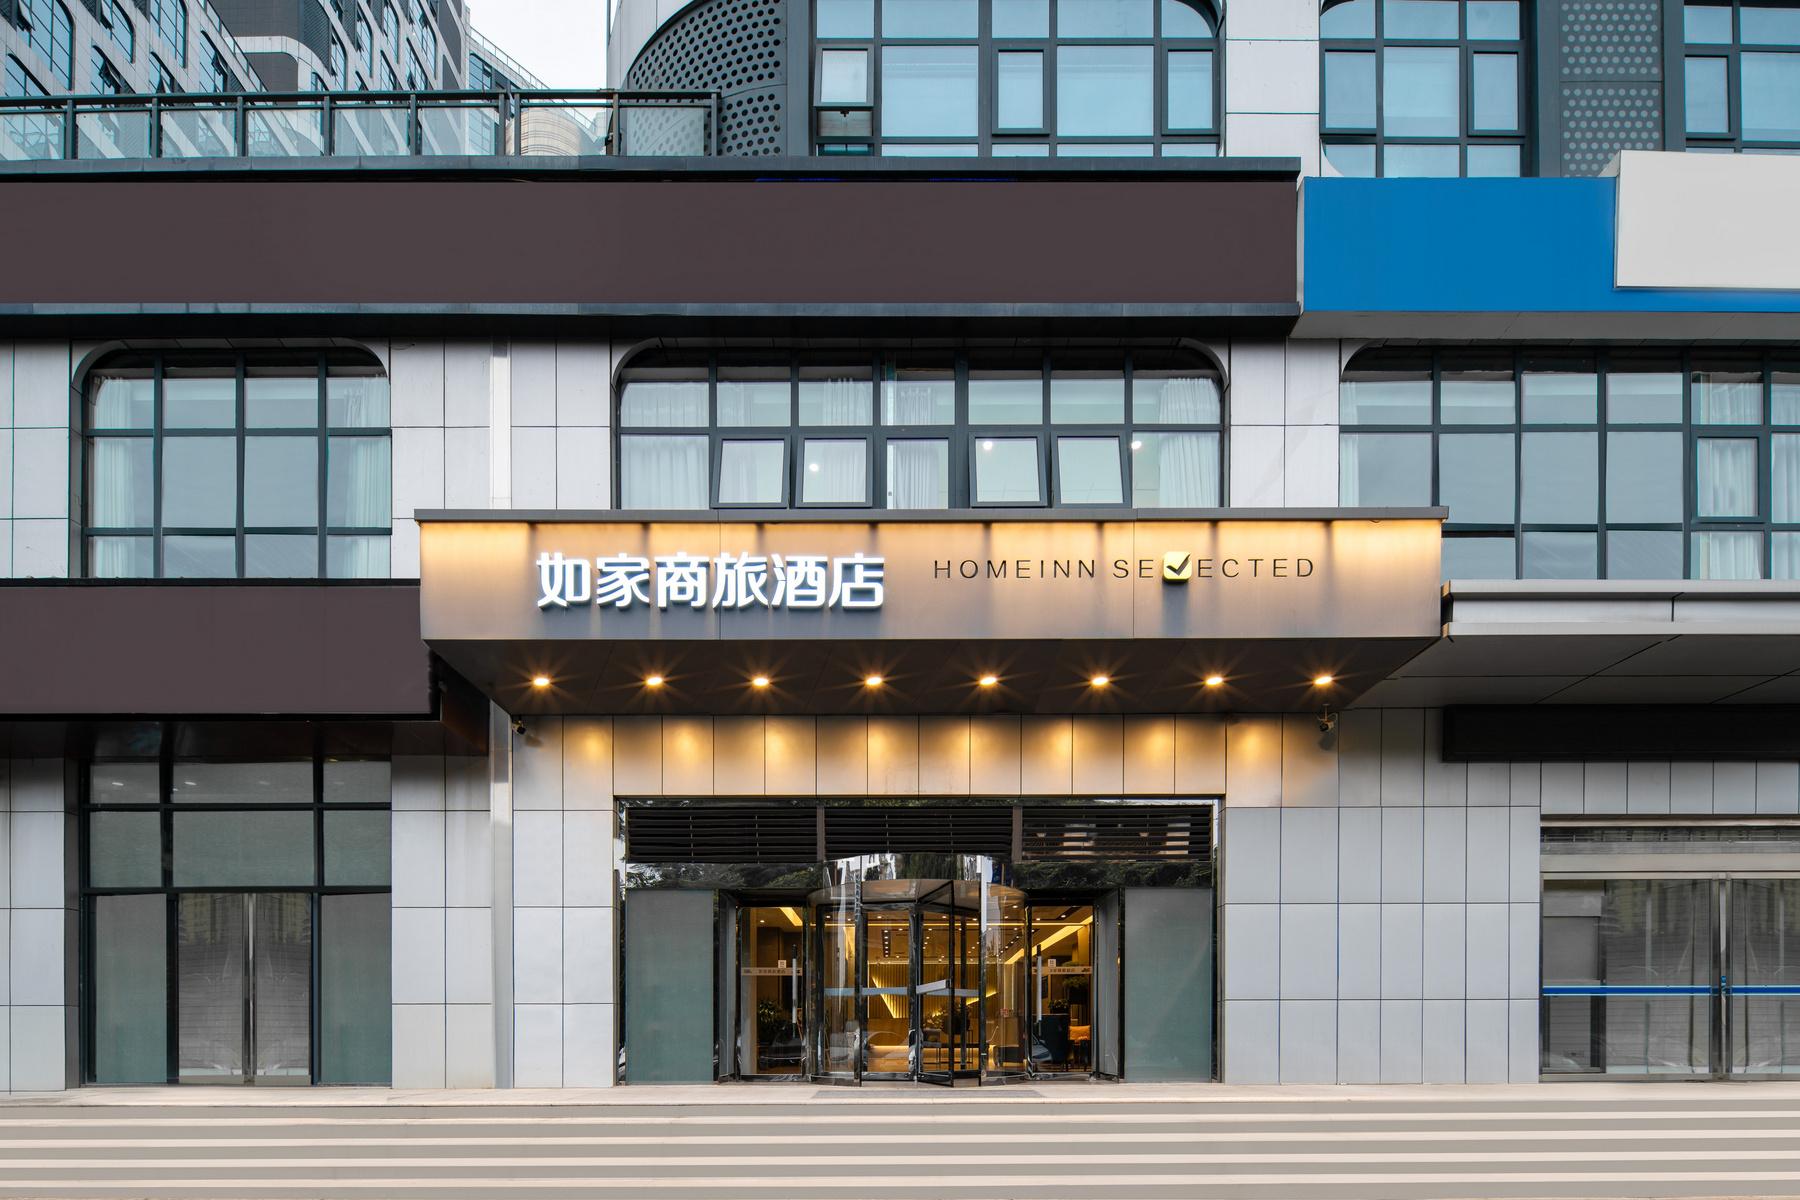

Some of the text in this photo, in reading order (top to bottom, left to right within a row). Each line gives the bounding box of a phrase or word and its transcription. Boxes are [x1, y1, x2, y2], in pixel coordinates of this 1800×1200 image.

[536, 552, 885, 608] 如家商旅酒店
[933, 559, 1096, 579] HOMEINN
